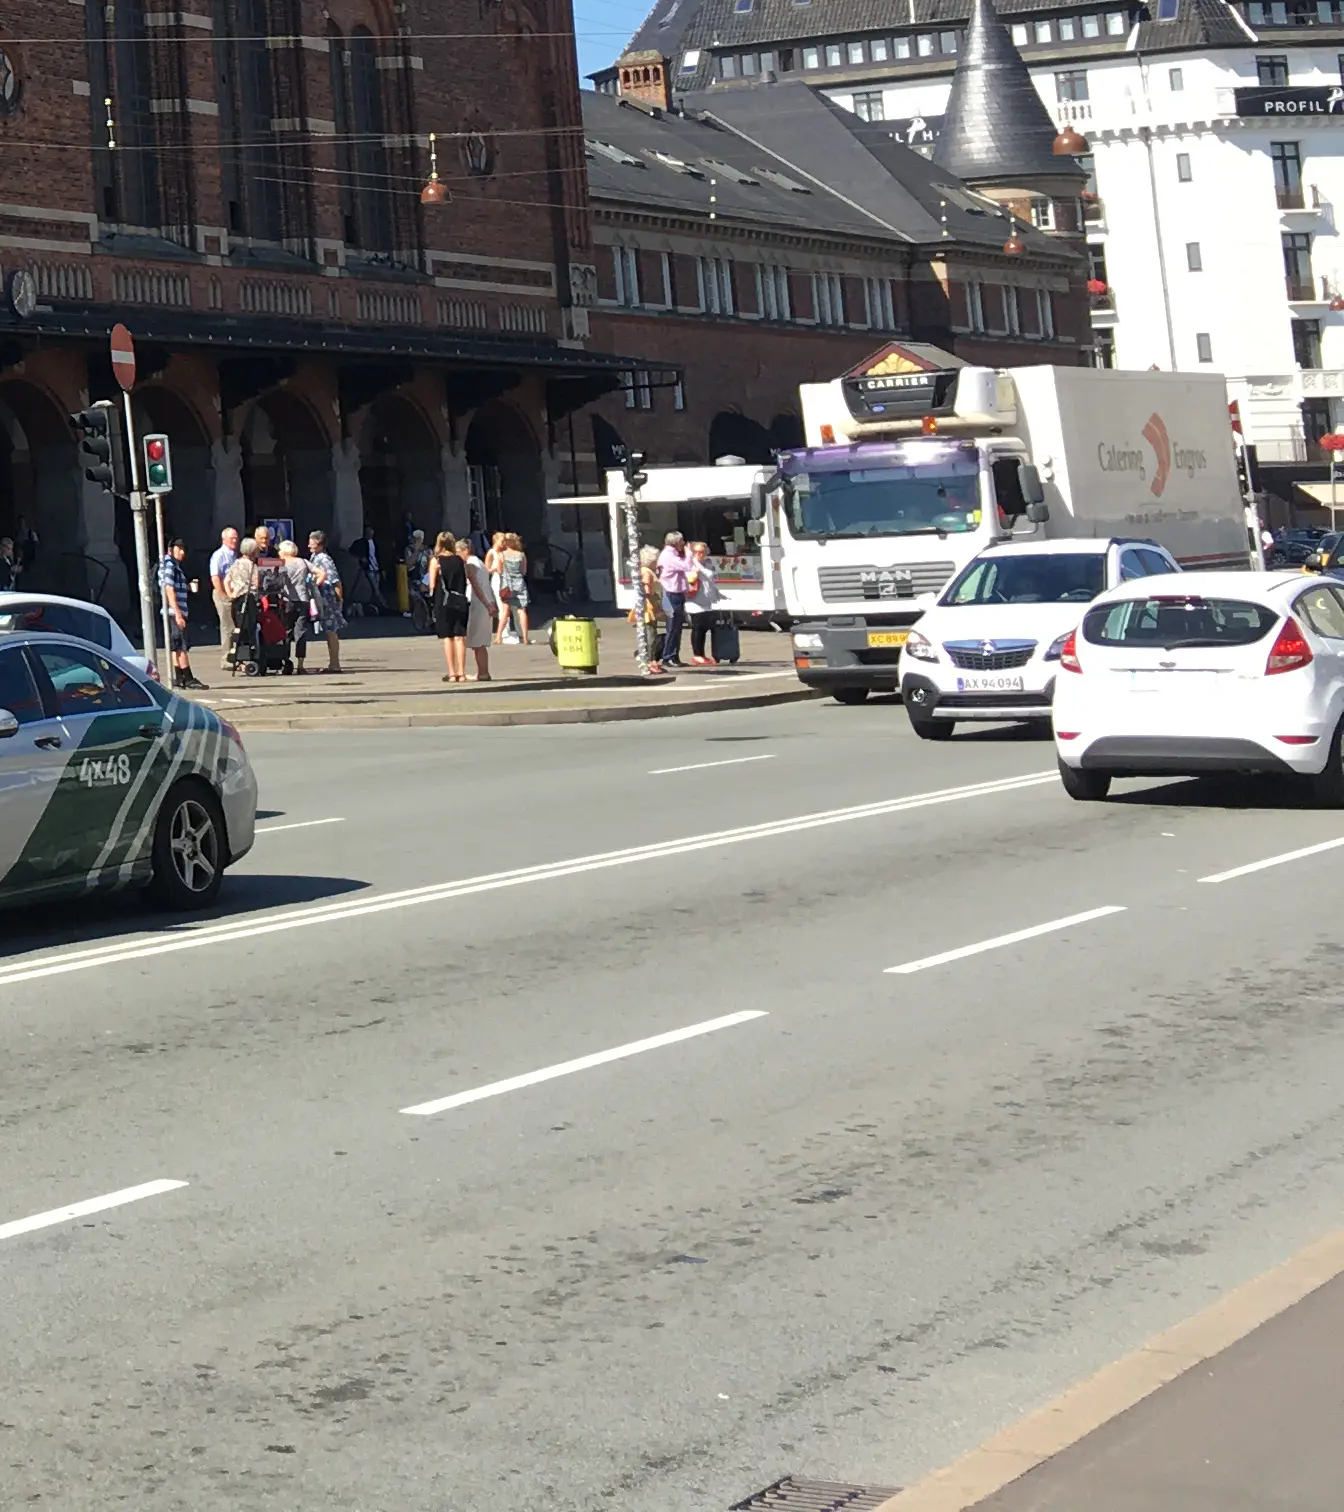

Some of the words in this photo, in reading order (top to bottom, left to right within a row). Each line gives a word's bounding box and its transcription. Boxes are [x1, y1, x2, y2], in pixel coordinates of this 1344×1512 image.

[1264, 100, 1324, 113] PROFIL
[867, 377, 928, 389] CARRIER
[1097, 441, 1146, 481] Catering
[1173, 441, 1207, 479] Engros
[859, 570, 911, 582] MAN
[870, 636, 884, 644] XC
[965, 678, 979, 688] AX
[981, 678, 996, 688] 94
[997, 678, 1019, 688] 094
[79, 754, 131, 787] 4x48
